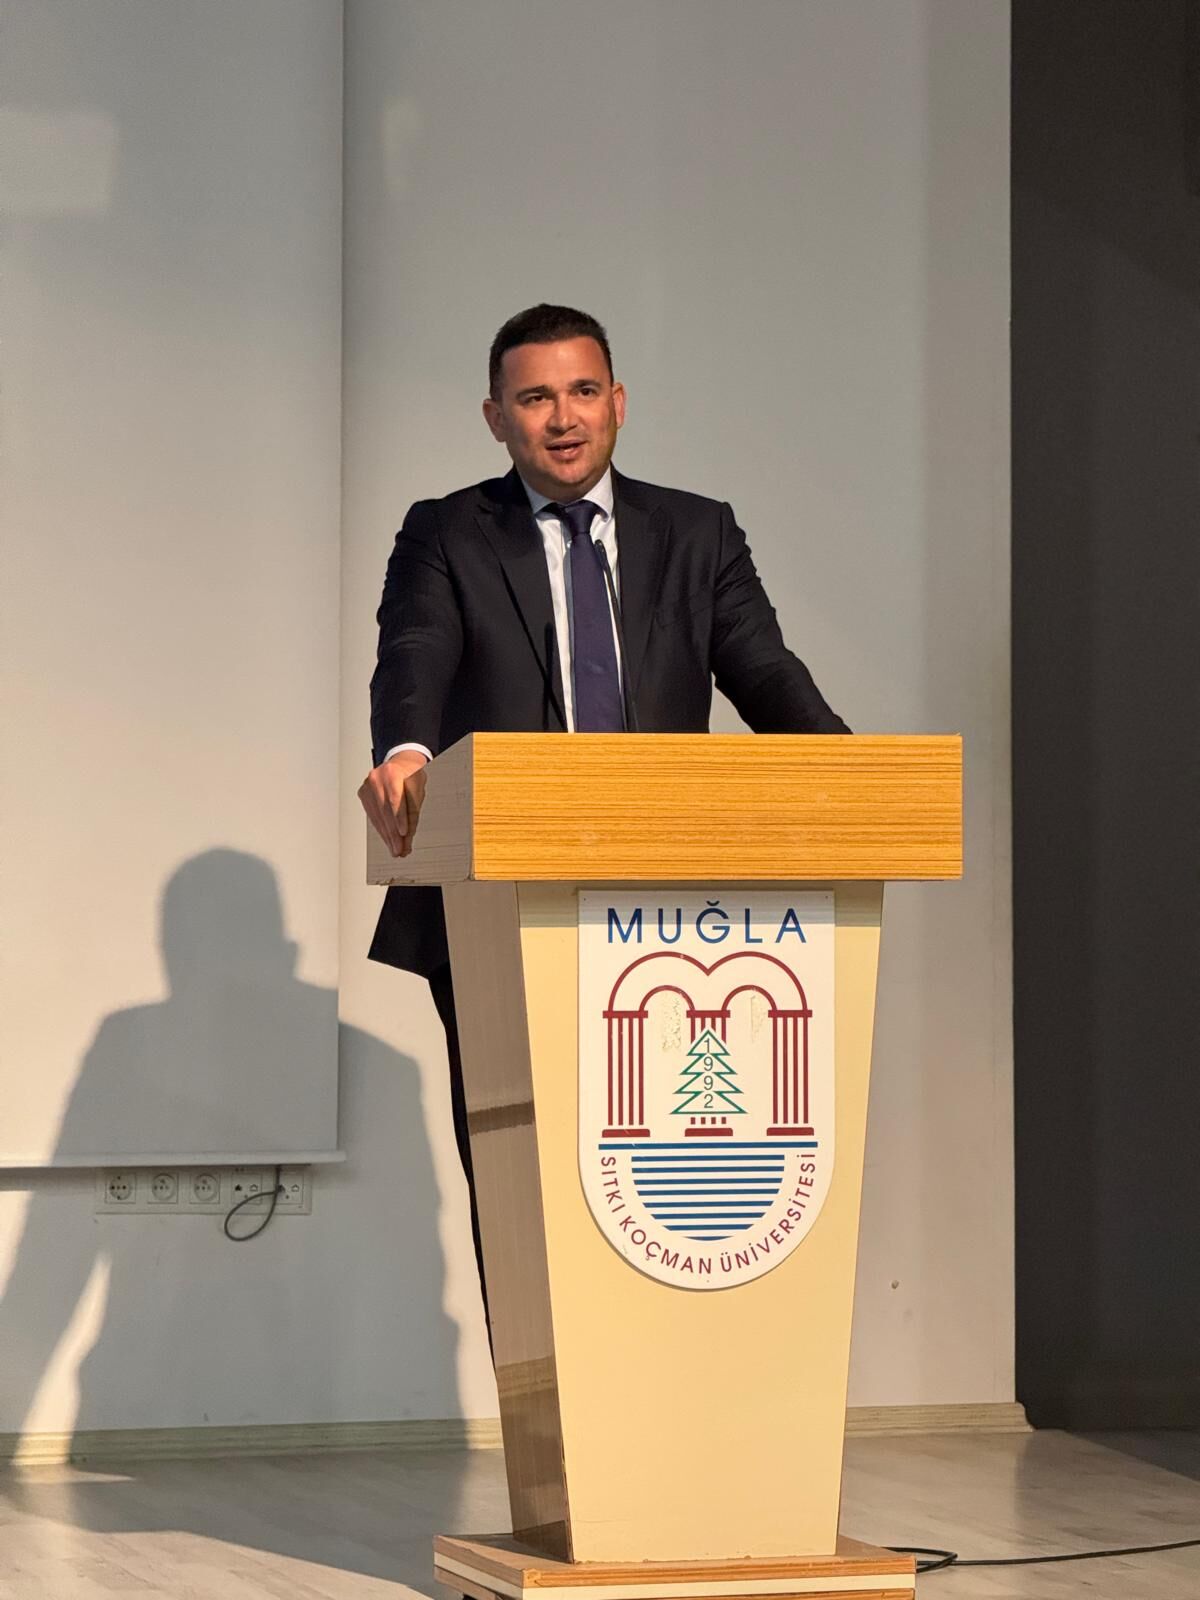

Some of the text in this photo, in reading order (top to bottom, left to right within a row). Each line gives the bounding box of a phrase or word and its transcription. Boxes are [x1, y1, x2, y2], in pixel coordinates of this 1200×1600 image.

[607, 900, 807, 944] MUĞLA
[703, 1037, 714, 1109] 1992
[601, 1154, 816, 1274] SITKI KOÇMAN ÜNİVERSİTESİ
